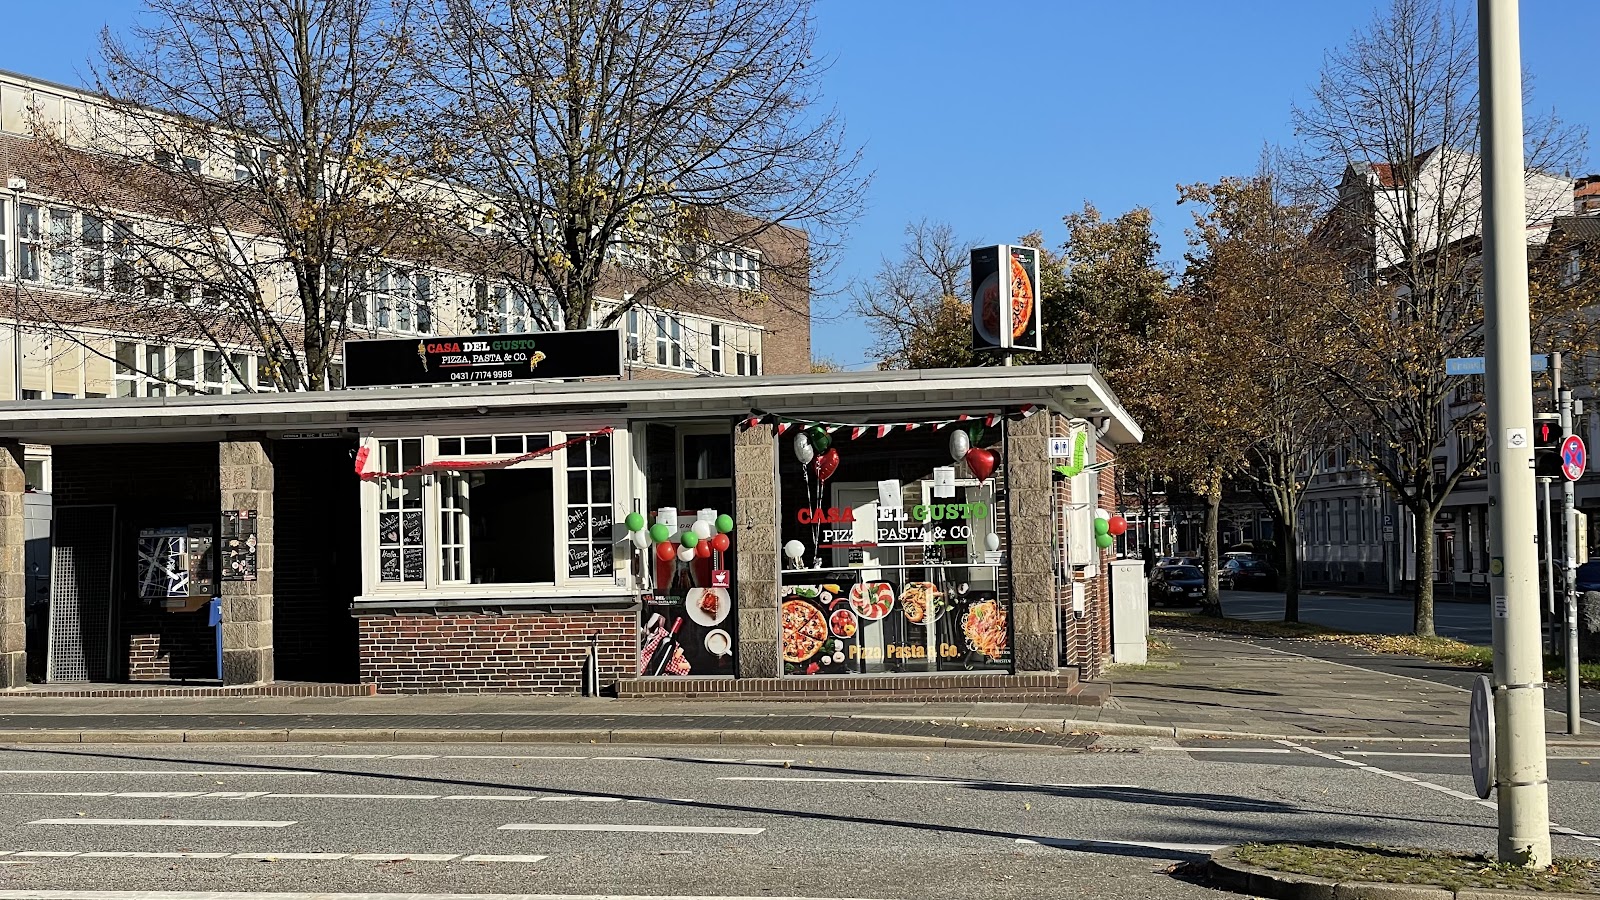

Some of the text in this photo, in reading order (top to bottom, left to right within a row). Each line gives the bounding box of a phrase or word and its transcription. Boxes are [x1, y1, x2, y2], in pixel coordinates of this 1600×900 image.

[427, 340, 535, 353] CASA DEL GUSTO
[442, 353, 527, 364] PIZZA, PASTA & CO.
[450, 370, 512, 380] 0431 / 7174 9988
[797, 502, 988, 524] CASA EL GUSTO
[1384, 515, 1391, 526] P
[933, 526, 946, 539] &
[887, 644, 925, 659] Pasta
[940, 643, 960, 658] Co.
